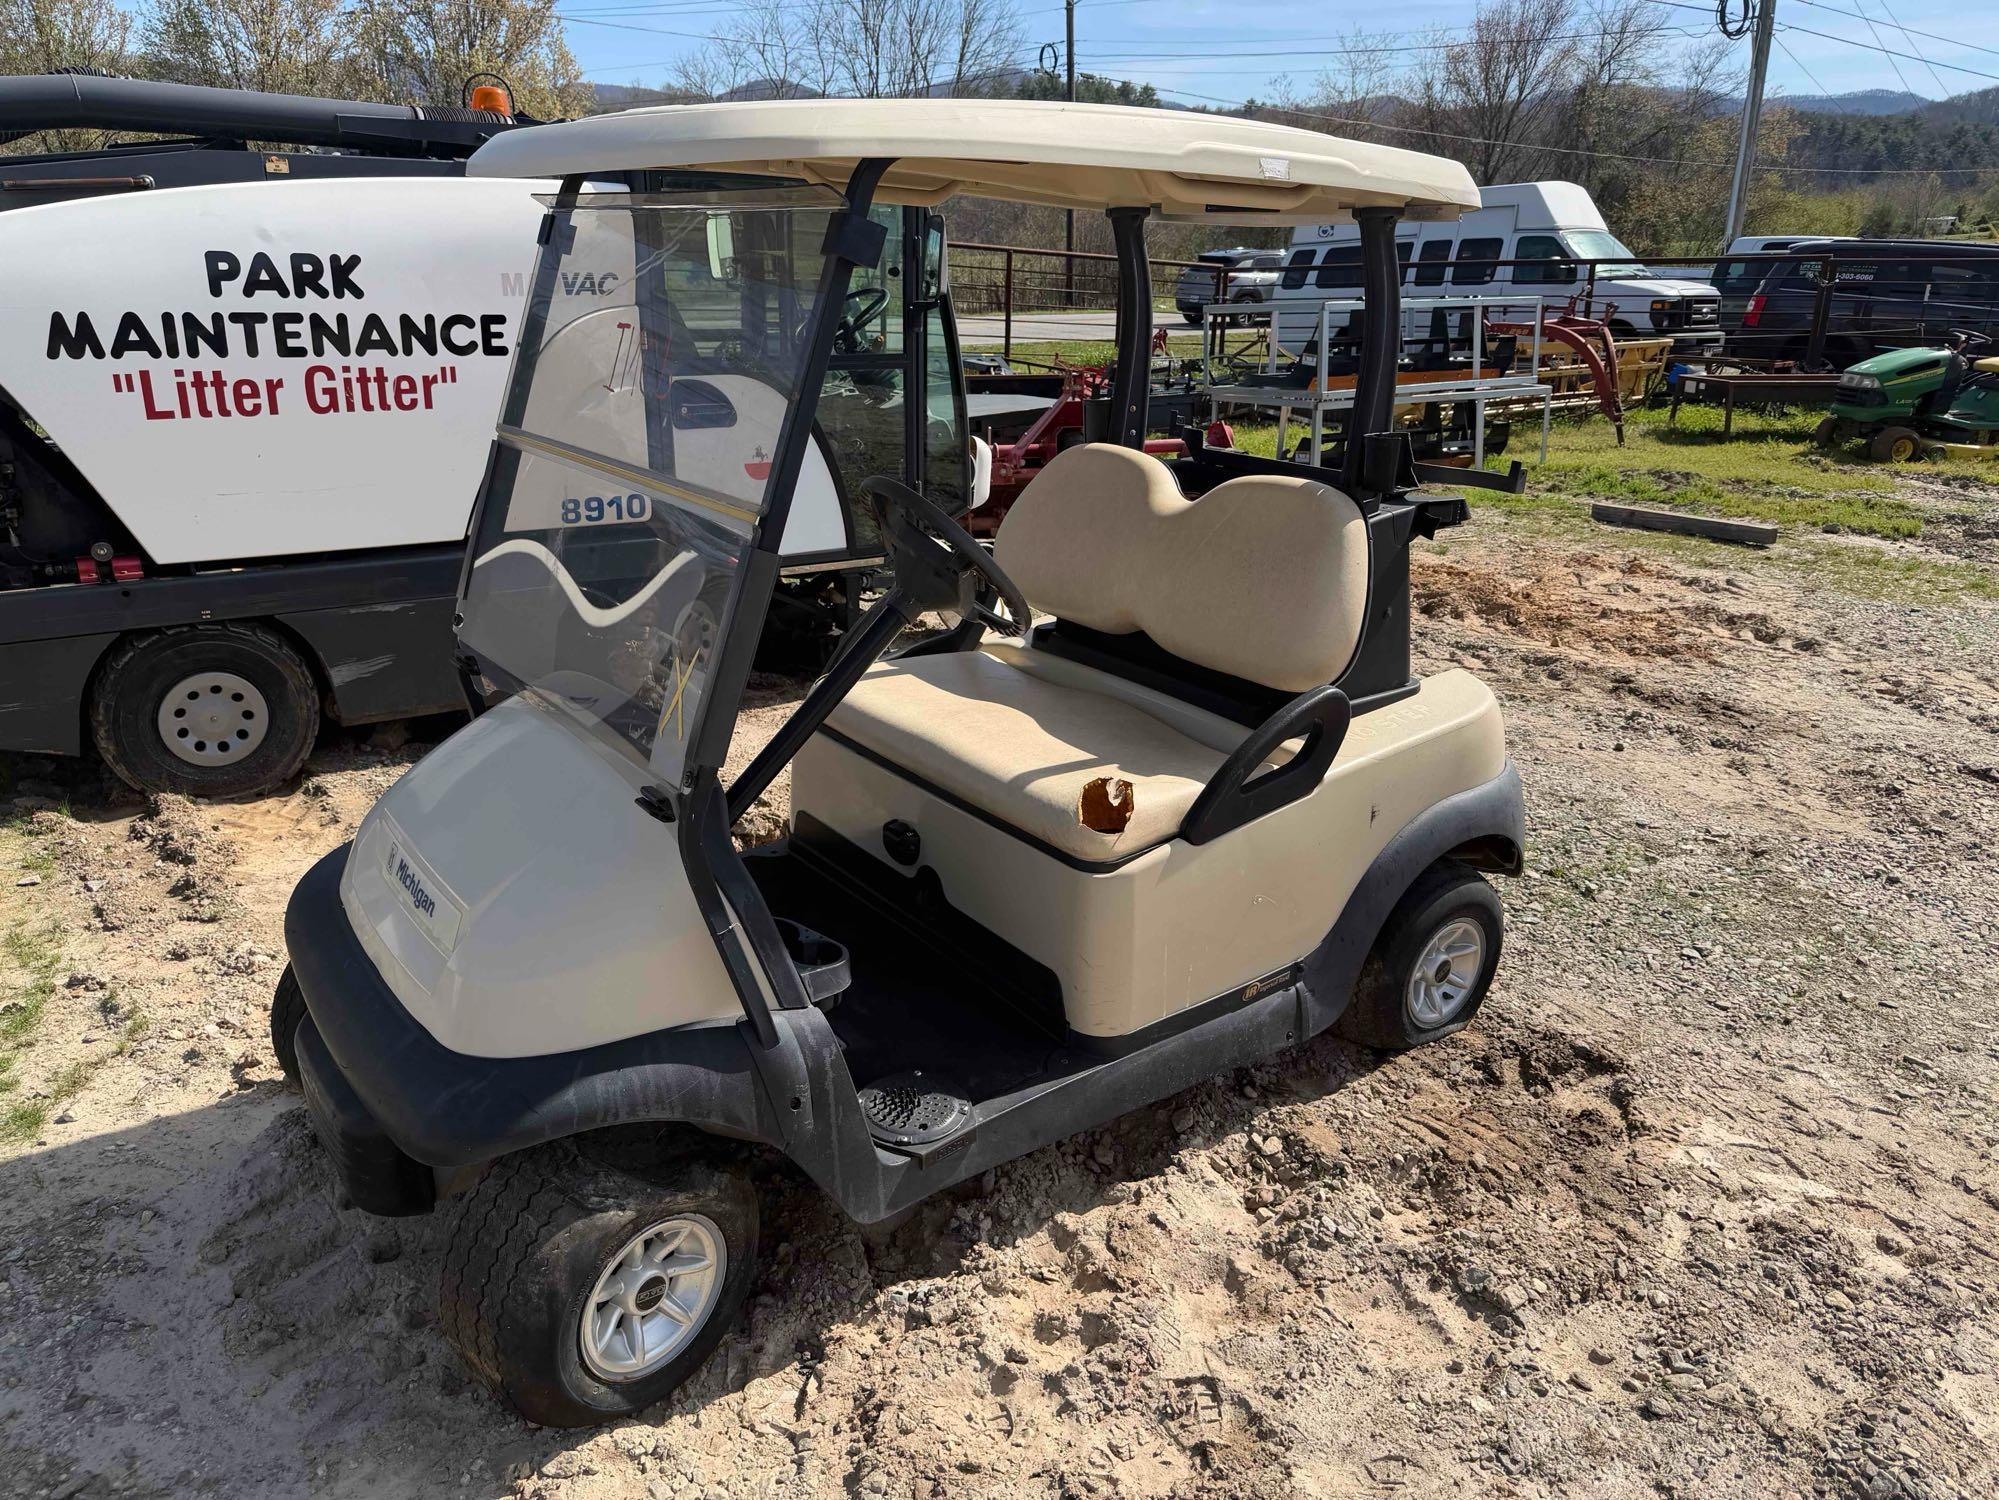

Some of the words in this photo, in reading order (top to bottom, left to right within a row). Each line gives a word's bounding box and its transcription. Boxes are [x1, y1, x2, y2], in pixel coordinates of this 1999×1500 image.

[205, 251, 364, 299] PARK
[47, 311, 509, 359] MAINTENANCE
[113, 370, 284, 420] "Litter
[305, 365, 457, 414] Gitter"
[561, 494, 646, 525] 8910
[396, 858, 436, 918] Michigan
